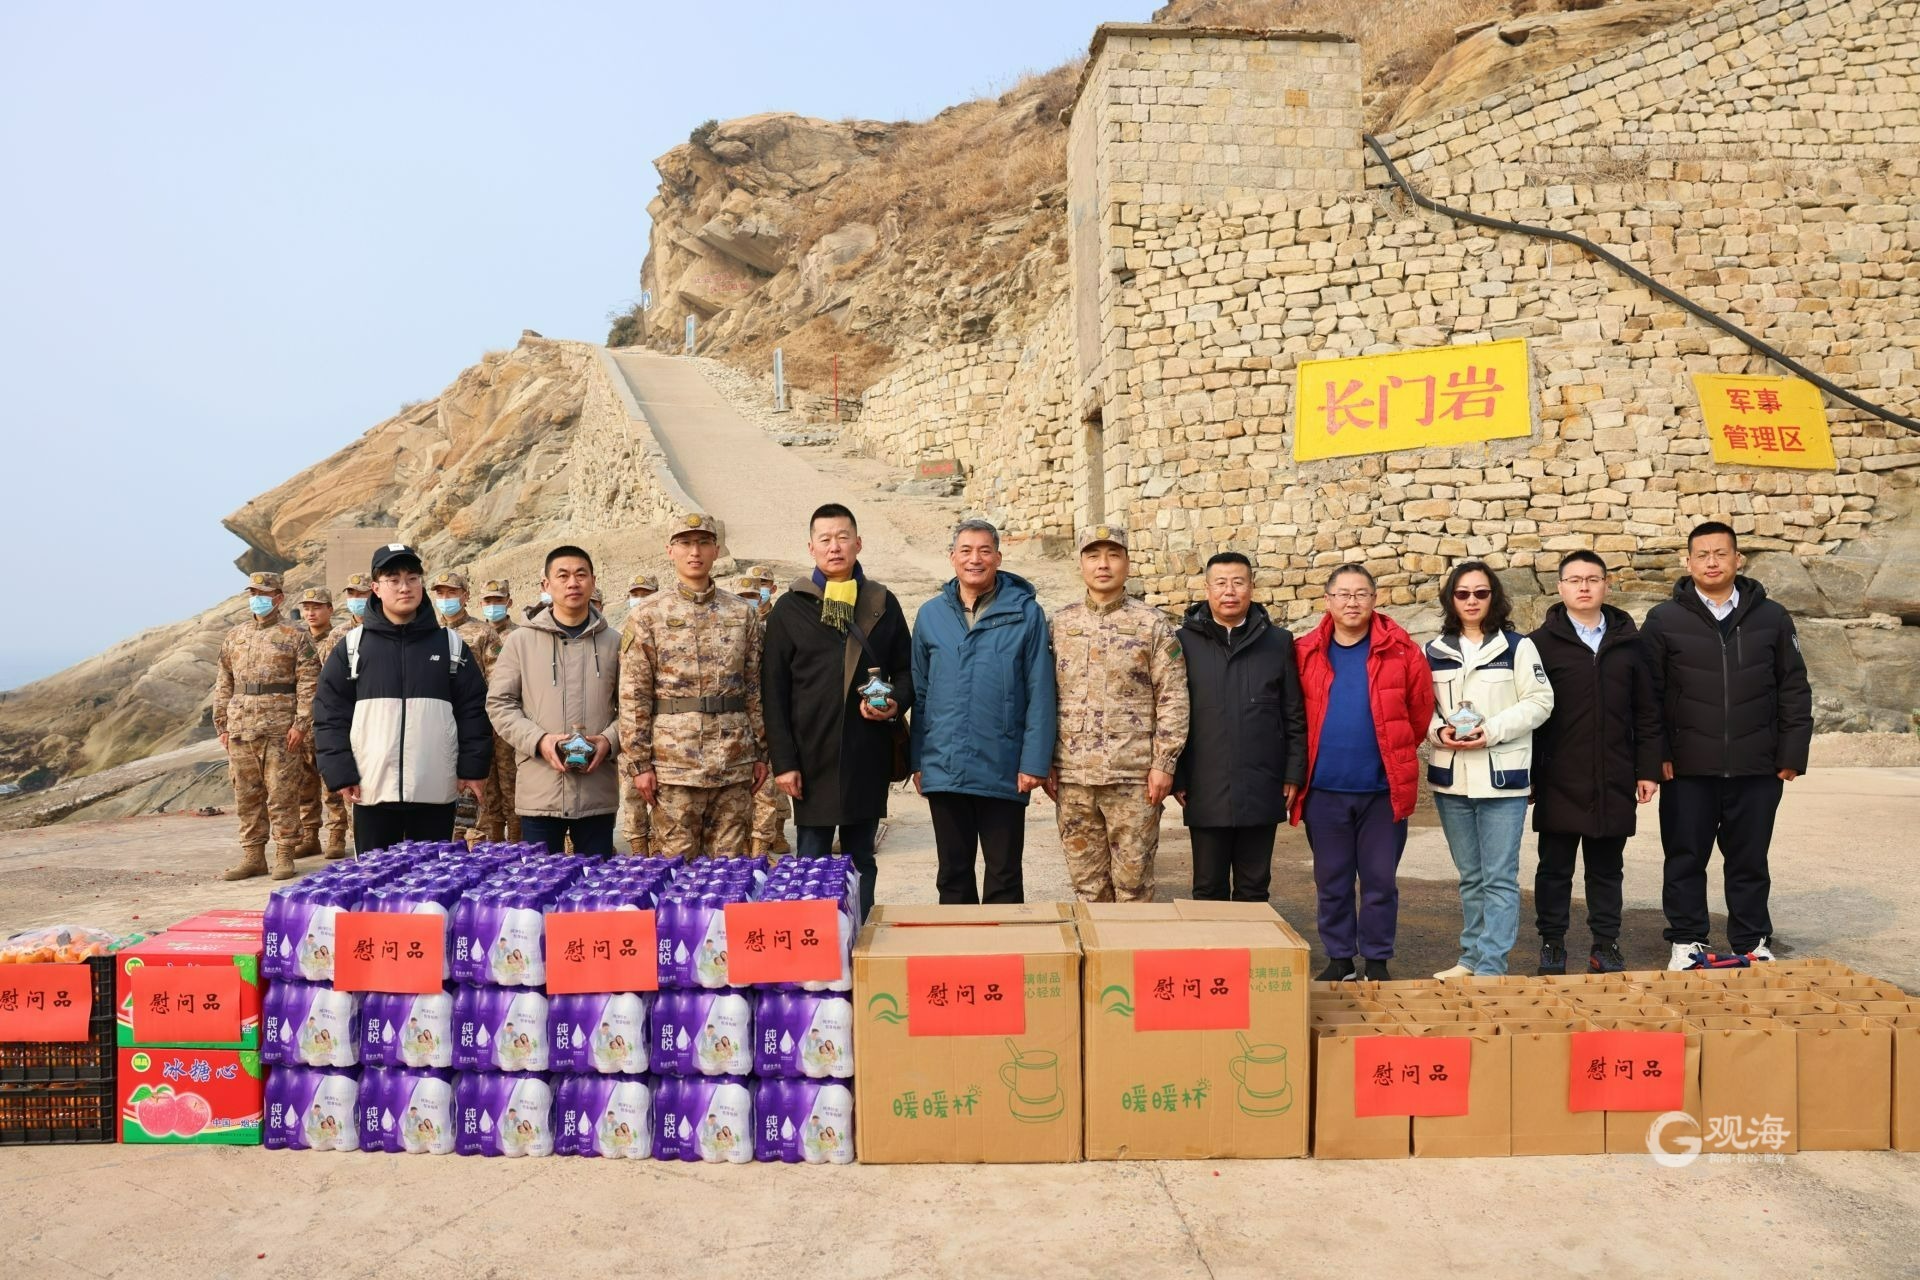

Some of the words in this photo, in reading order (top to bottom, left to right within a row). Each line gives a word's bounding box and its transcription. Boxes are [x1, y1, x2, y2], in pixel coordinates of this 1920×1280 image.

[1316, 365, 1505, 437] 长门岩
[1725, 387, 1783, 414] 军事
[1722, 423, 1806, 453] 管理区
[353, 937, 425, 962] 慰问品
[565, 937, 638, 963] 慰问品
[658, 938, 672, 965] 纯悦
[745, 928, 819, 953] 慰问品
[0, 987, 72, 1012] 慰问品
[927, 982, 1004, 1007] 慰问品
[1153, 976, 1229, 1001] 慰问品
[150, 991, 221, 1015] 慰问品
[266, 1016, 278, 1043] 纯悦
[367, 1018, 380, 1044] 纯悦
[461, 1022, 474, 1048] 纯悦
[556, 1022, 569, 1049] 纯悦
[661, 1024, 674, 1051] 纯悦
[764, 1028, 777, 1055] 纯悦
[163, 1058, 238, 1082] 冰糖心
[1374, 1061, 1449, 1087] 慰问品
[1586, 1056, 1663, 1081] 慰问品
[893, 1090, 977, 1120] 暖暖杯
[1122, 1084, 1206, 1112] 暖暖杯
[270, 1103, 282, 1129] 纯悦
[366, 1106, 379, 1132] 纯悦
[464, 1107, 477, 1134] 纯悦
[564, 1110, 576, 1137] 纯悦
[663, 1113, 676, 1139] 纯悦
[766, 1115, 778, 1141] 纯悦
